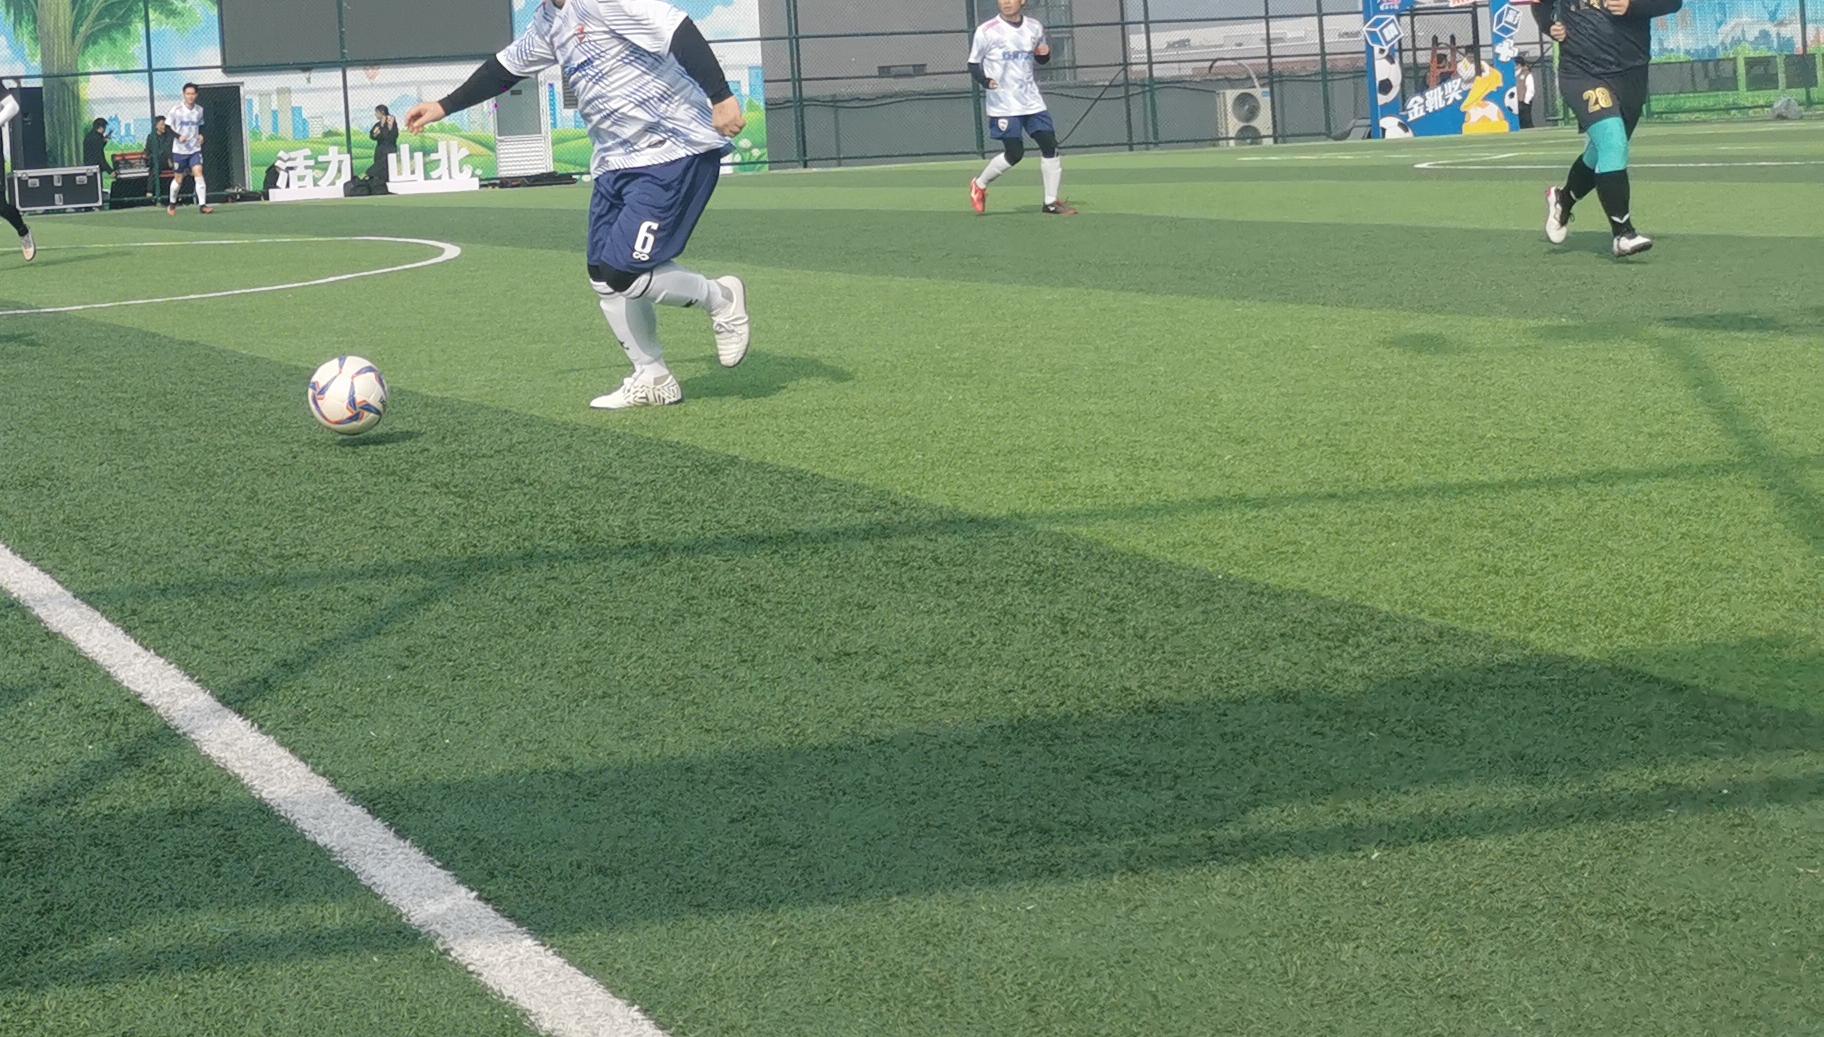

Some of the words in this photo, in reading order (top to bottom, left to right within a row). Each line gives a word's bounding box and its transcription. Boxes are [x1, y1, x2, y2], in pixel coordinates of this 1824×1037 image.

[1406, 77, 1464, 122] 金靴奖
[1582, 86, 1613, 113] 28
[274, 146, 352, 190] 活力
[387, 140, 473, 182] 山北
[634, 220, 659, 254] 6
